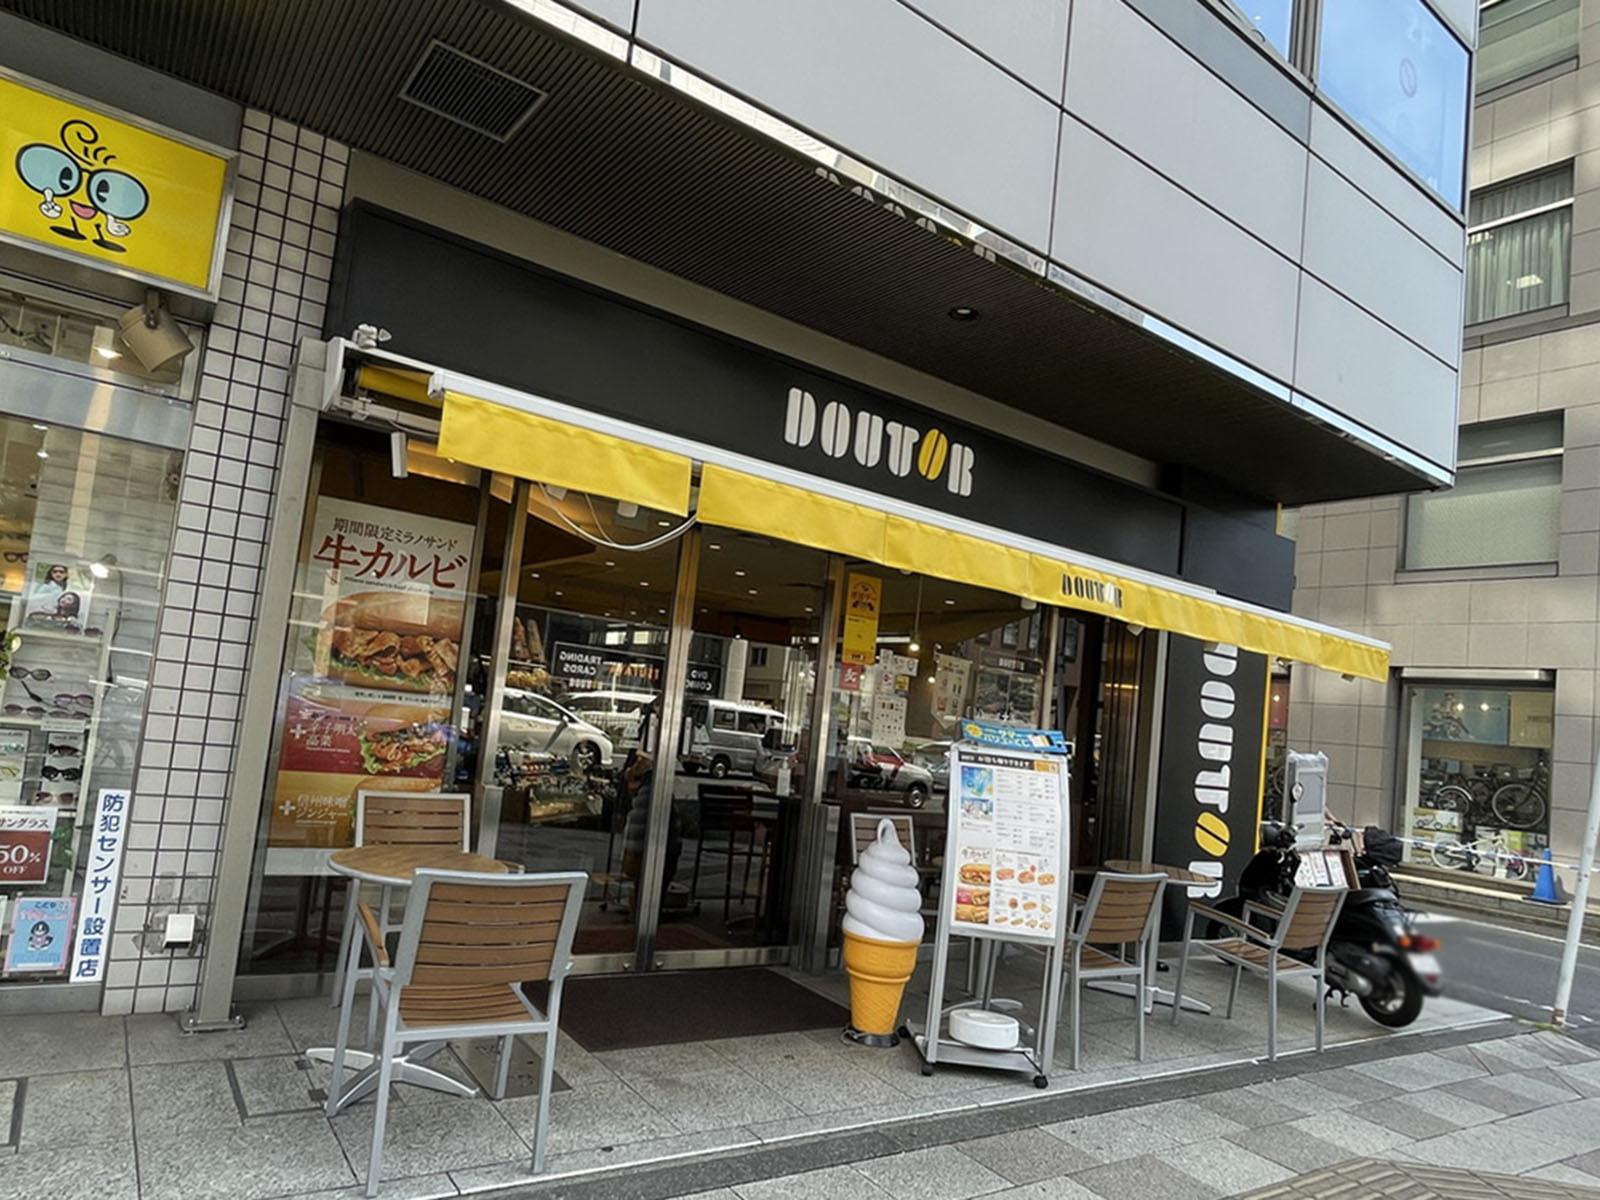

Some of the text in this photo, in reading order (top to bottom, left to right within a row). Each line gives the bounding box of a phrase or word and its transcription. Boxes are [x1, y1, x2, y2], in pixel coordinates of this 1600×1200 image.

[784, 387, 975, 497] DOUTOR
[313, 533, 468, 589] 牛カルビ
[332, 517, 458, 552] 期間限定ミラノサンド
[1062, 574, 1123, 609] DOUTOR
[1186, 642, 1239, 899] DOUTOR
[75, 794, 125, 977] 防犯センサー設置店
